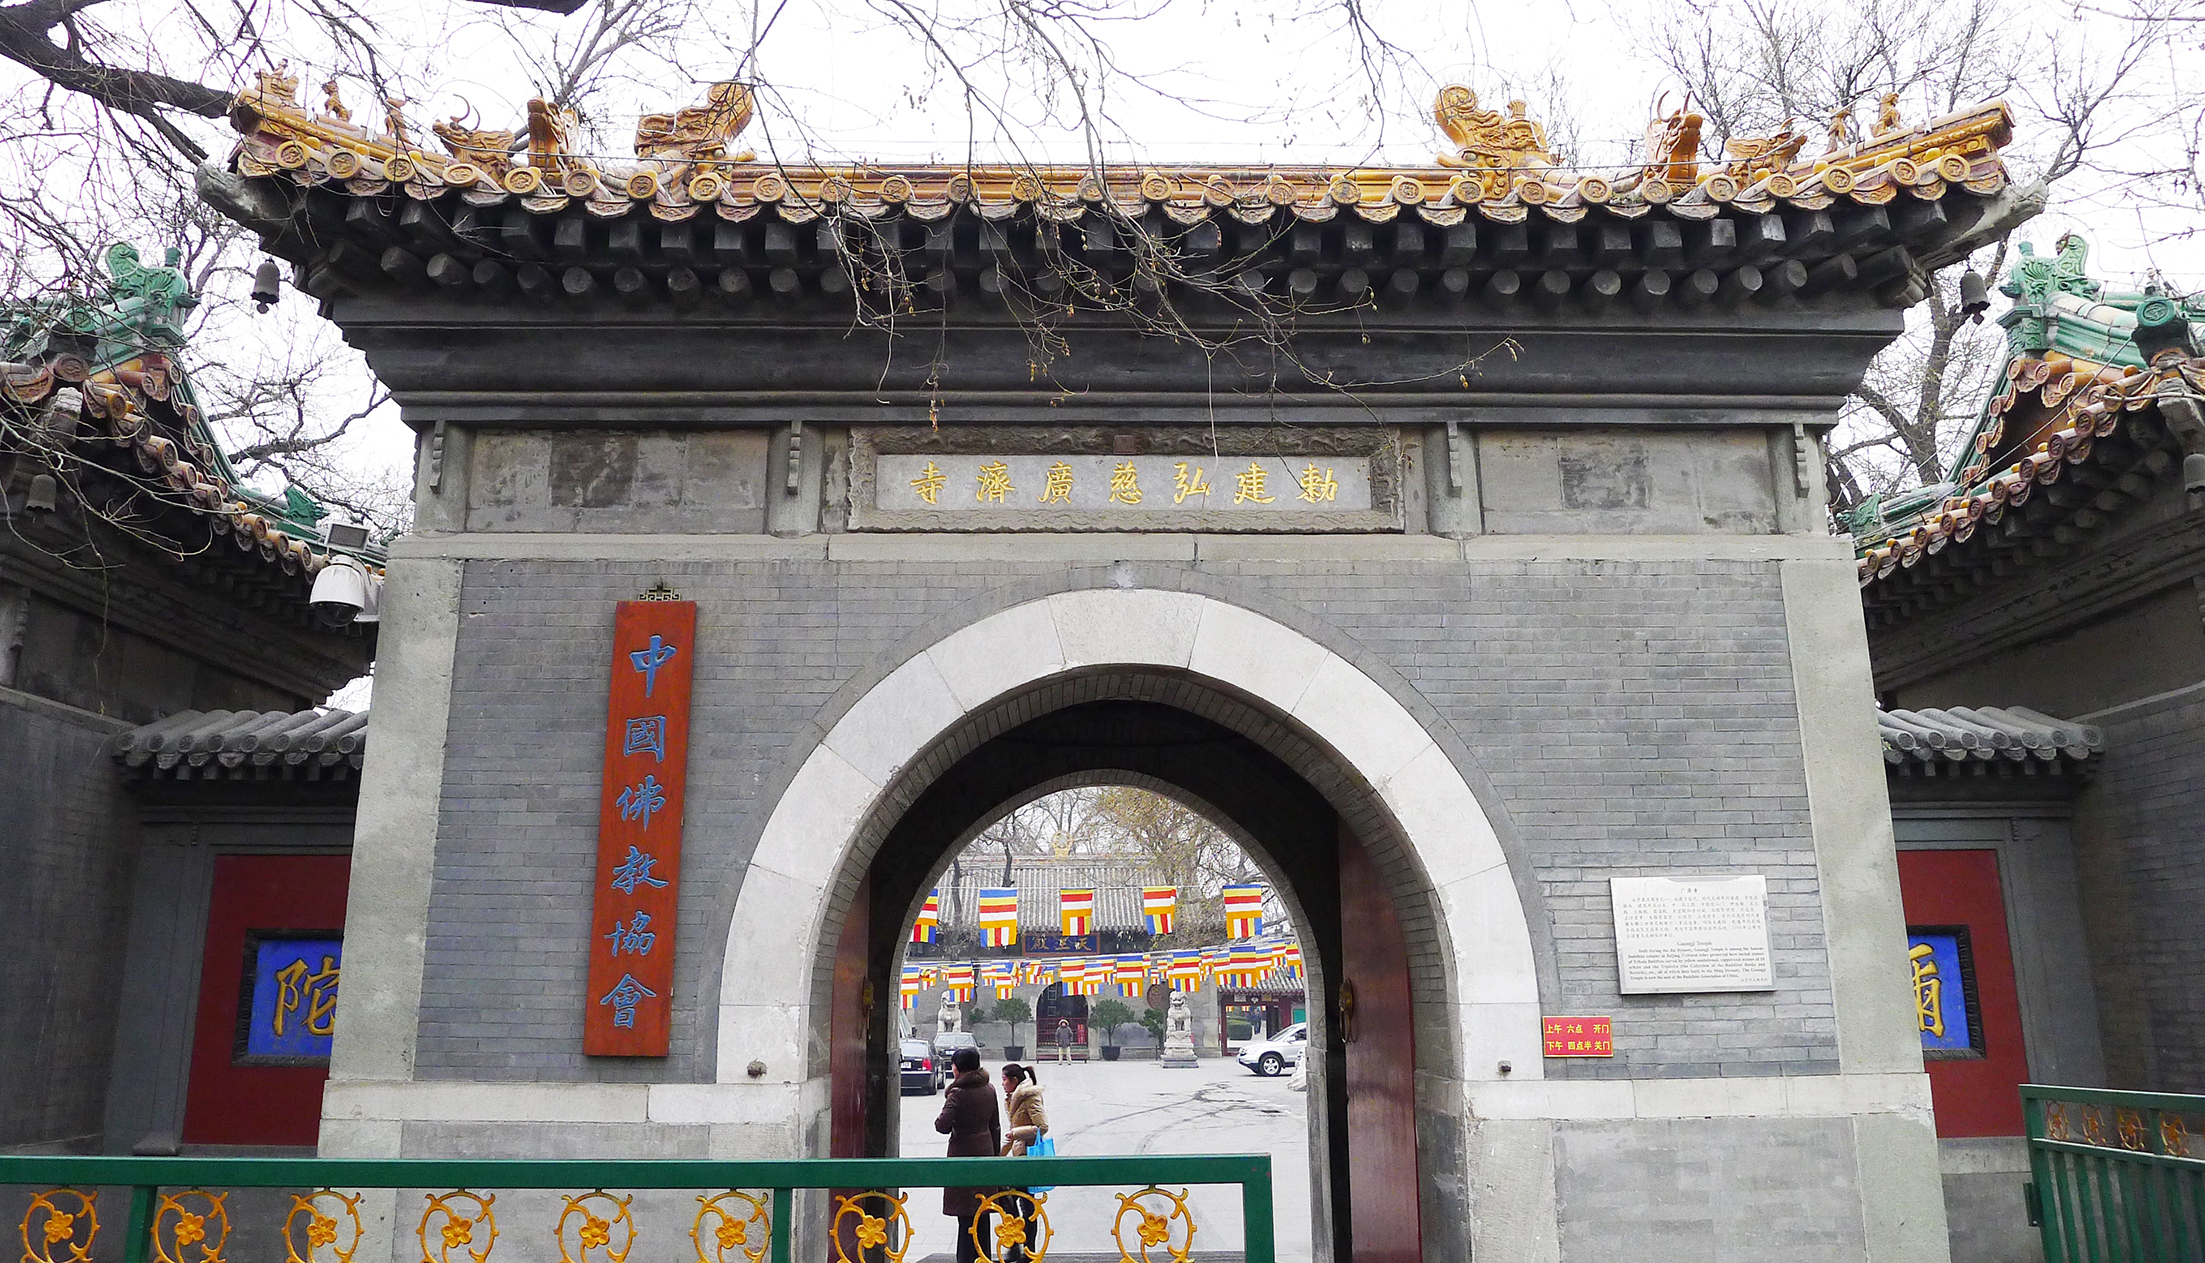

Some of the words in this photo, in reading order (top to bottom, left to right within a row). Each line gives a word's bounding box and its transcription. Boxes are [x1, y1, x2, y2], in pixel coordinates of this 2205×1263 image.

[600, 634, 677, 1029] 中國佛教協會
[1546, 1024, 1562, 1034] 上午
[1566, 1024, 1583, 1034] 六点
[1593, 1024, 1610, 1034] 开门
[1546, 1041, 1563, 1051] 下午
[1568, 1041, 1592, 1051] 四点半
[1594, 1041, 1610, 1051] 关门
